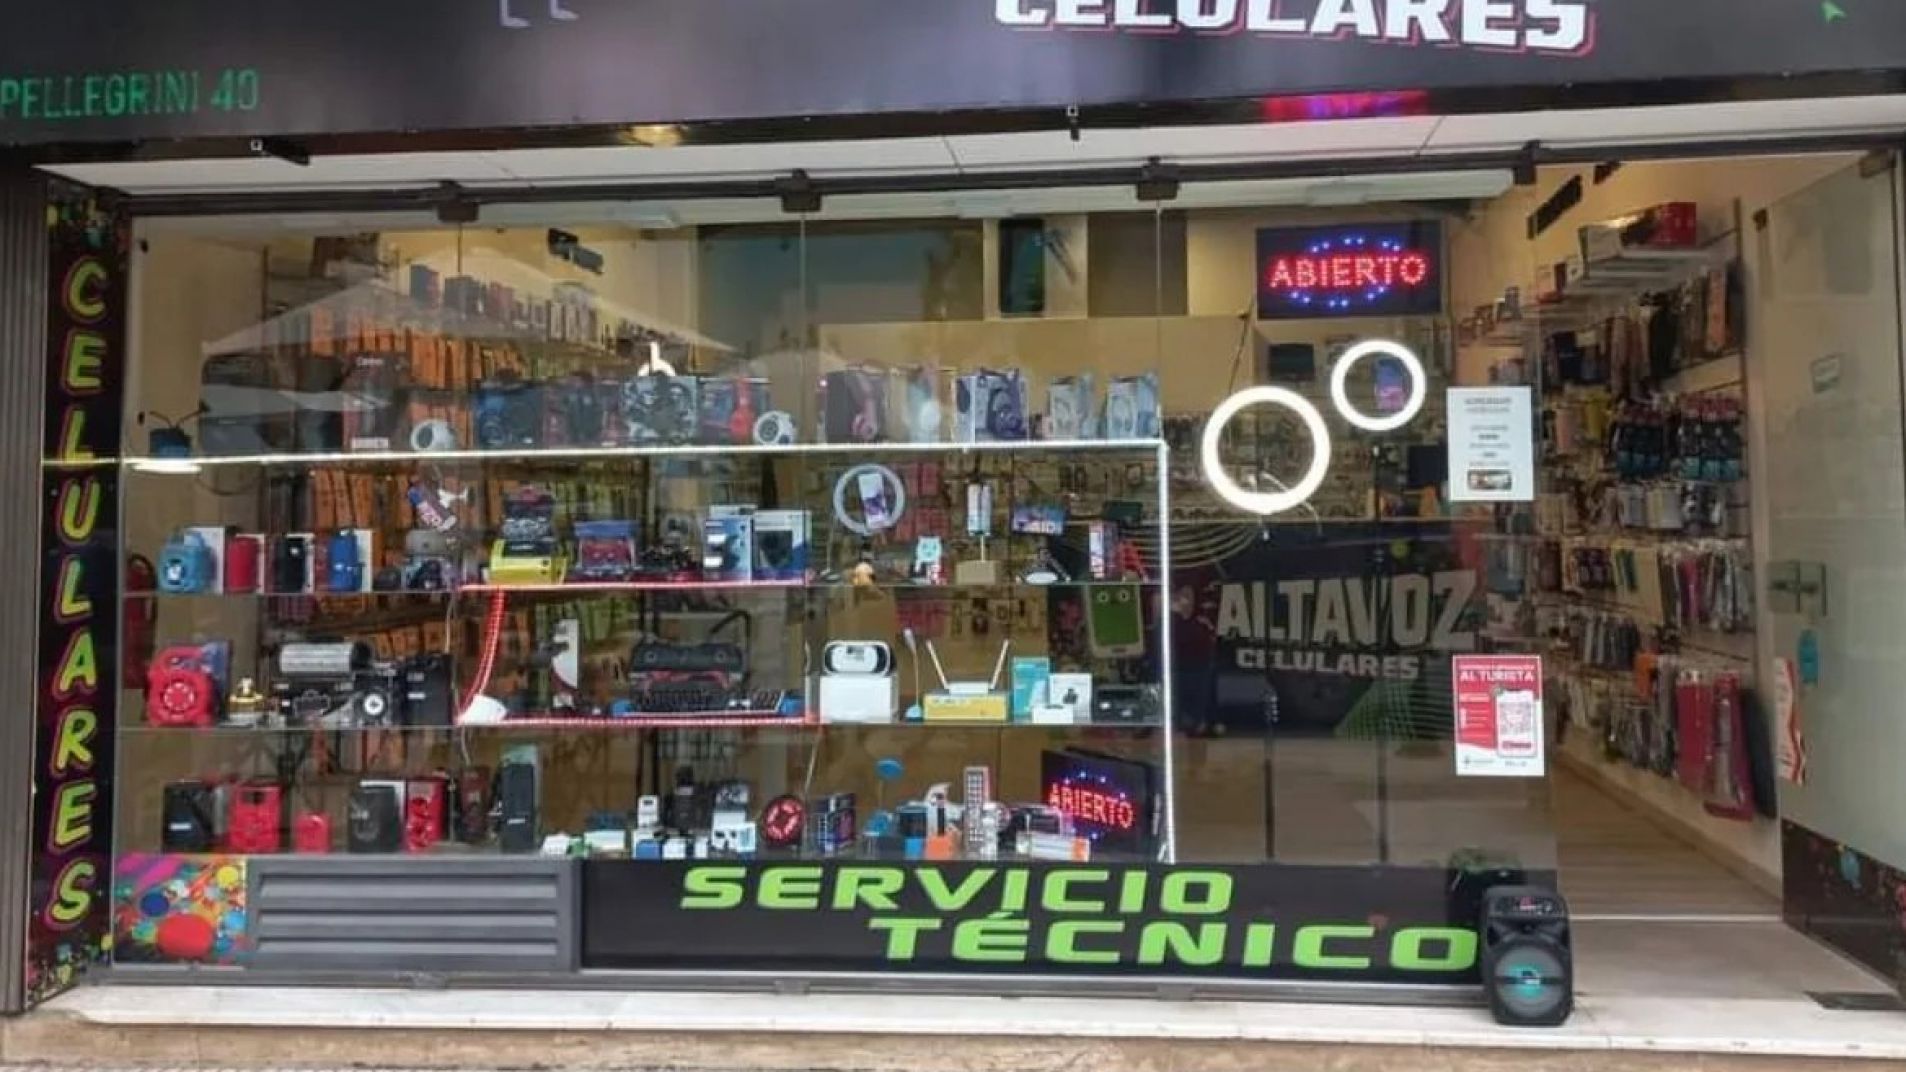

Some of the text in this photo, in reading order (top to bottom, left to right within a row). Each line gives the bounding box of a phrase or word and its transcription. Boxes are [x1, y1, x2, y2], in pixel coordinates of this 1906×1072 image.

[0, 68, 259, 118] PELLEGRINI 40
[1269, 255, 1427, 288] ABIERTO
[48, 254, 108, 926] CELULARES
[1217, 569, 1477, 649] ALTAVOZ
[1048, 783, 1133, 829] ABIERTO
[679, 866, 1233, 913] SERVICIO
[869, 911, 1478, 971] TÉCNICO
